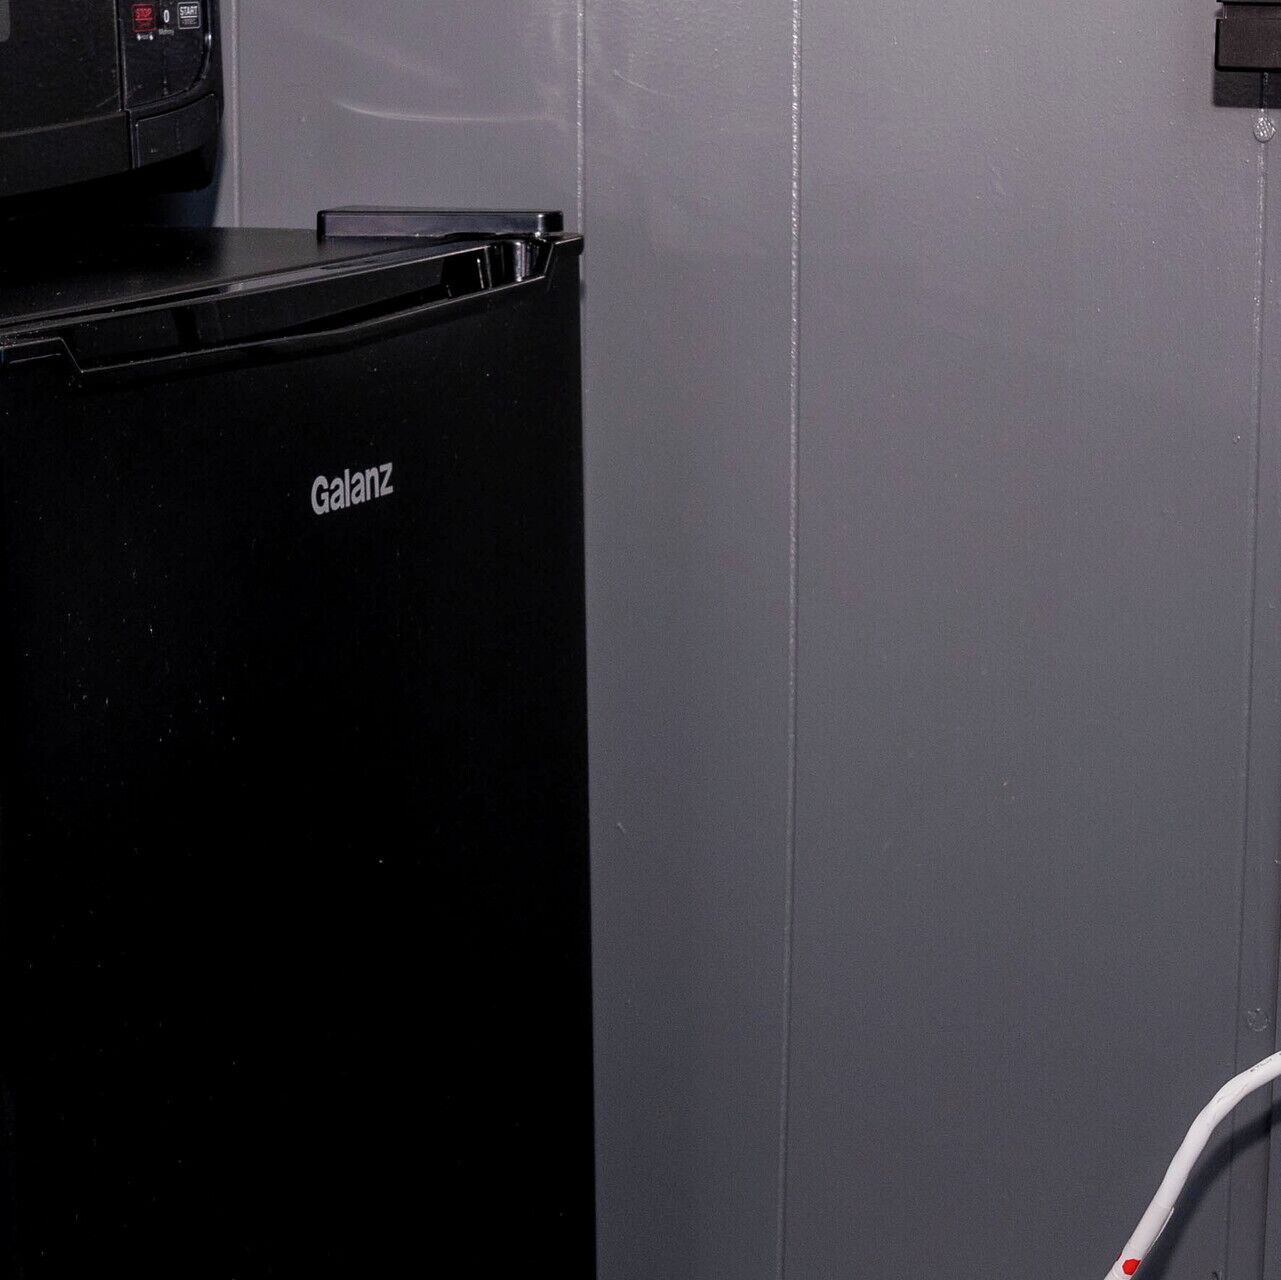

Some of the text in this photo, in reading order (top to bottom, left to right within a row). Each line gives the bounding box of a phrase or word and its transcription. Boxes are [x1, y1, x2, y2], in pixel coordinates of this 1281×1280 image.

[163, 9, 170, 23] 0
[179, 5, 198, 16] START
[310, 462, 394, 515] Galanz
